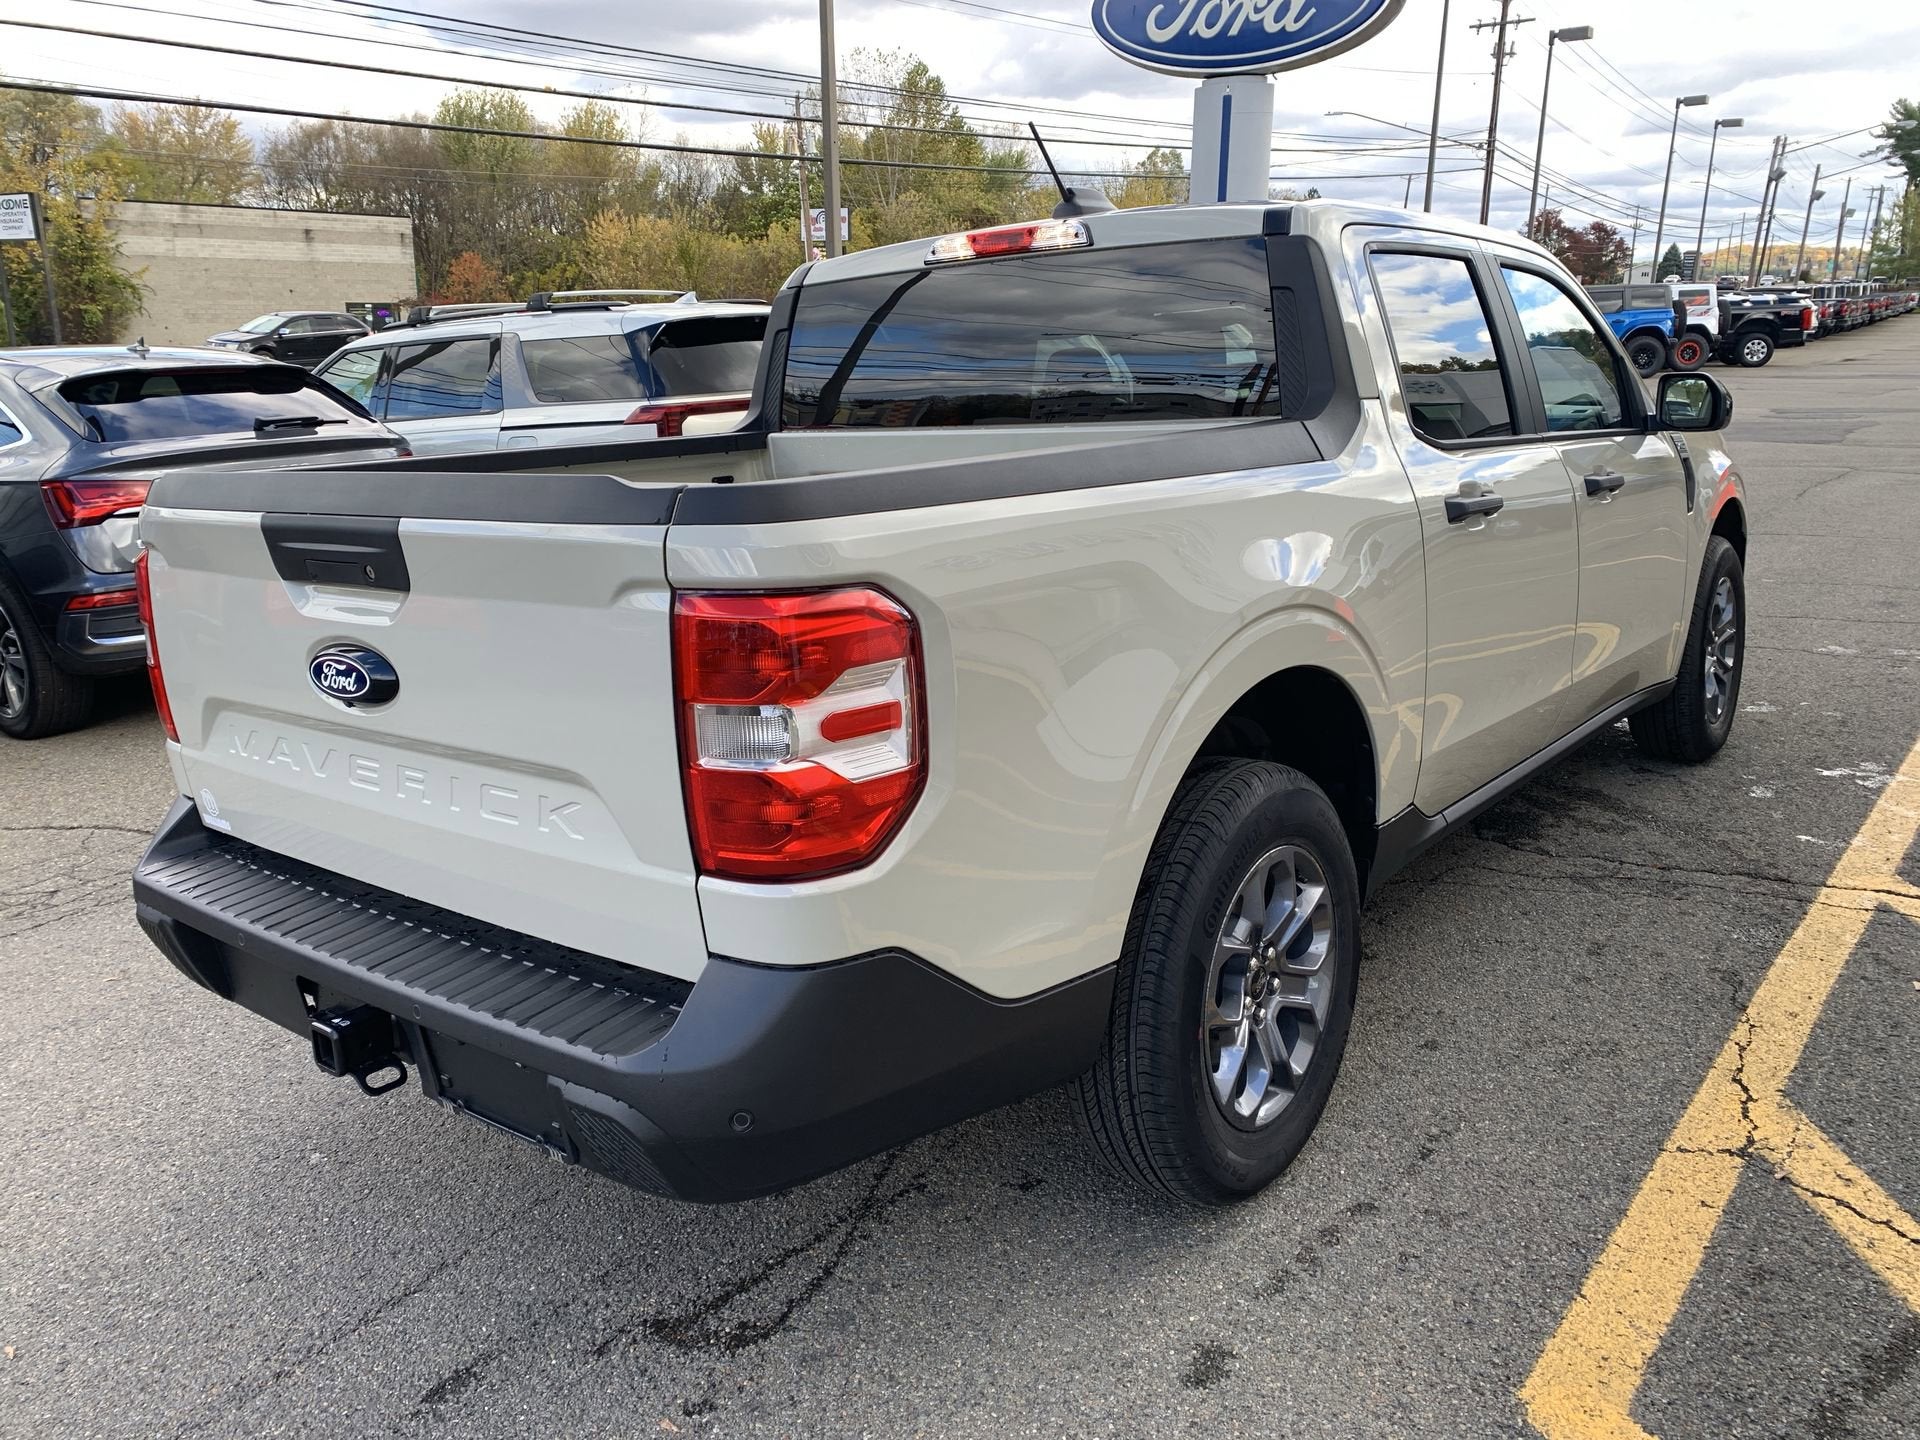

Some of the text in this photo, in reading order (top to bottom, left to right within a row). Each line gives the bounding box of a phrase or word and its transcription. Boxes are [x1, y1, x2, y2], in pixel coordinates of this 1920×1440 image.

[0, 199, 29, 210] OOME
[321, 661, 357, 692] Ford
[229, 723, 585, 841] MAVERICK
[1203, 820, 1264, 939] Continental
